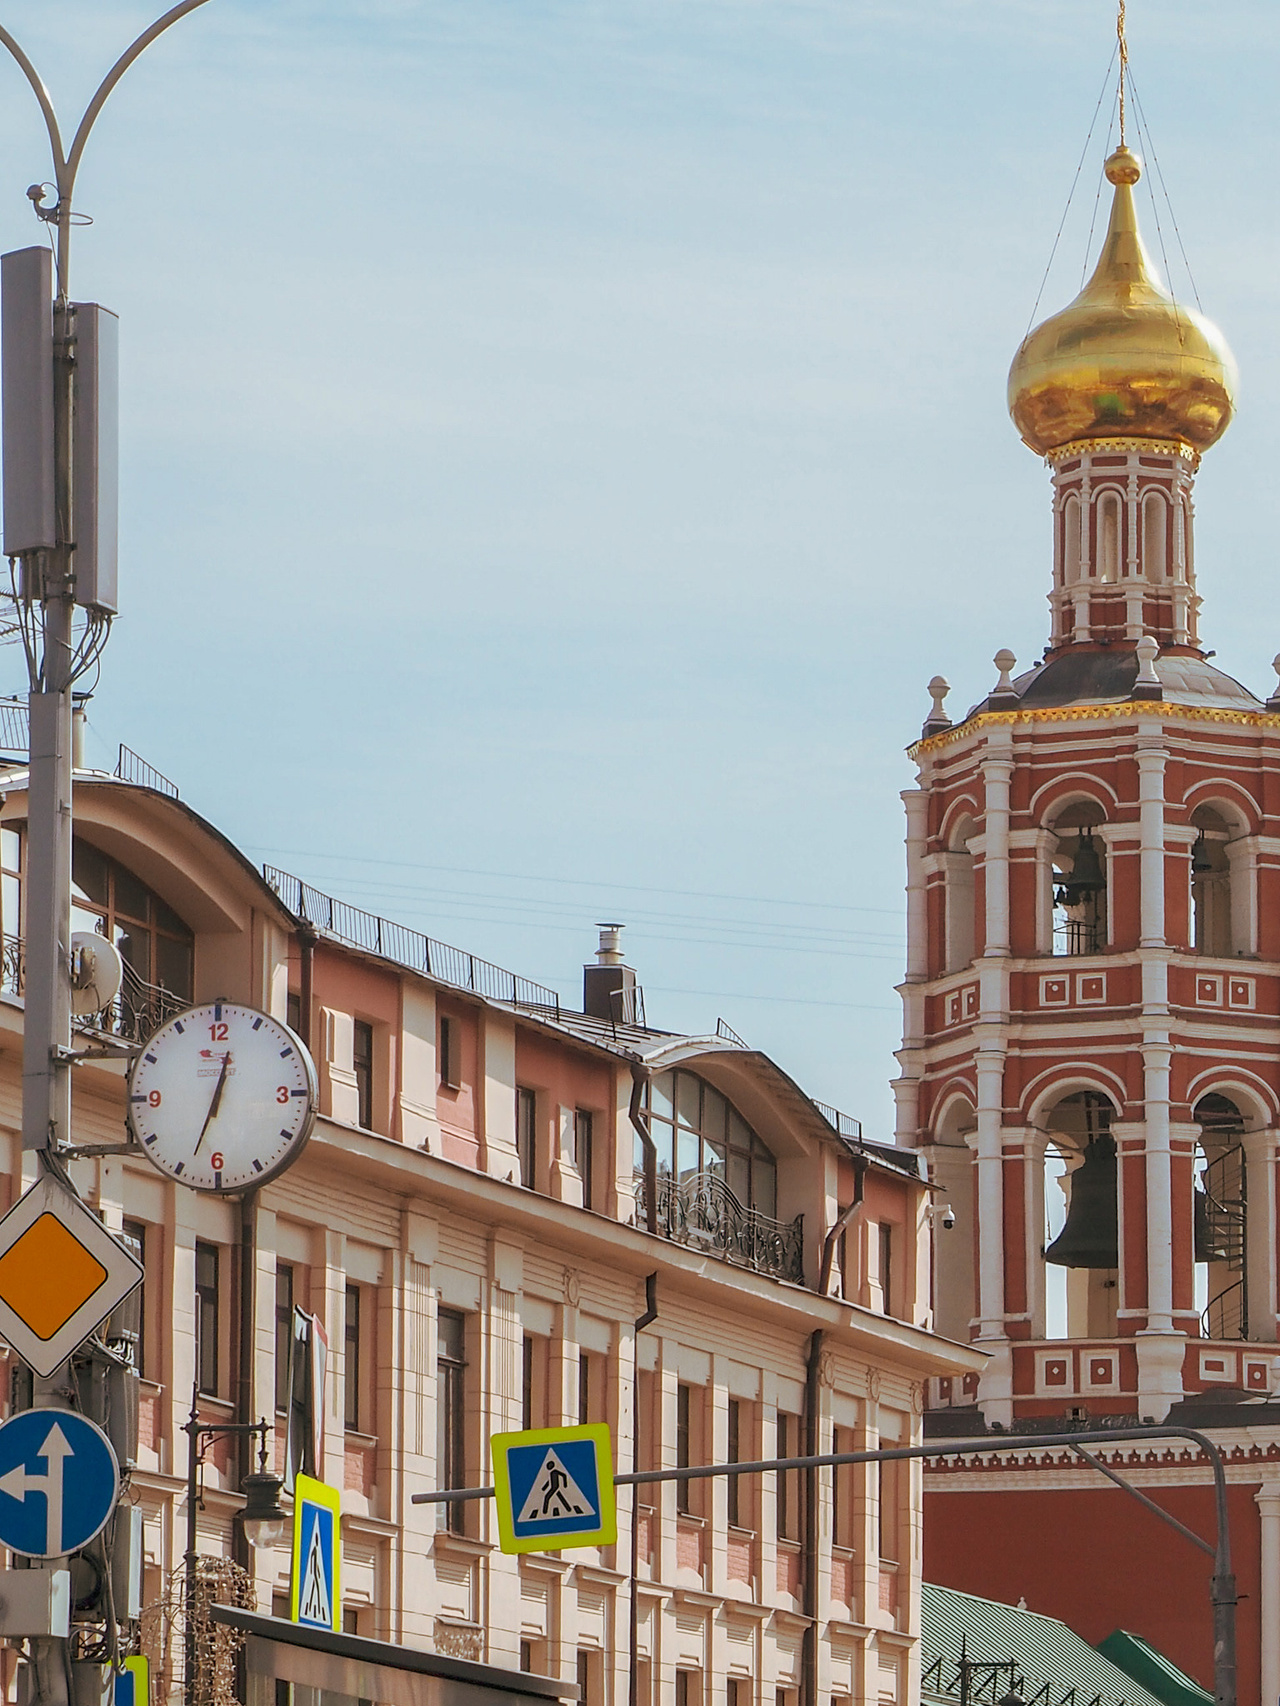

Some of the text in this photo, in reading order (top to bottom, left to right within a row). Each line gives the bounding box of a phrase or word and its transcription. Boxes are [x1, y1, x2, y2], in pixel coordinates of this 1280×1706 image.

[208, 1022, 229, 1042] 12
[149, 1090, 162, 1108] 9
[275, 1085, 289, 1104] 3
[210, 1151, 224, 1170] 6
